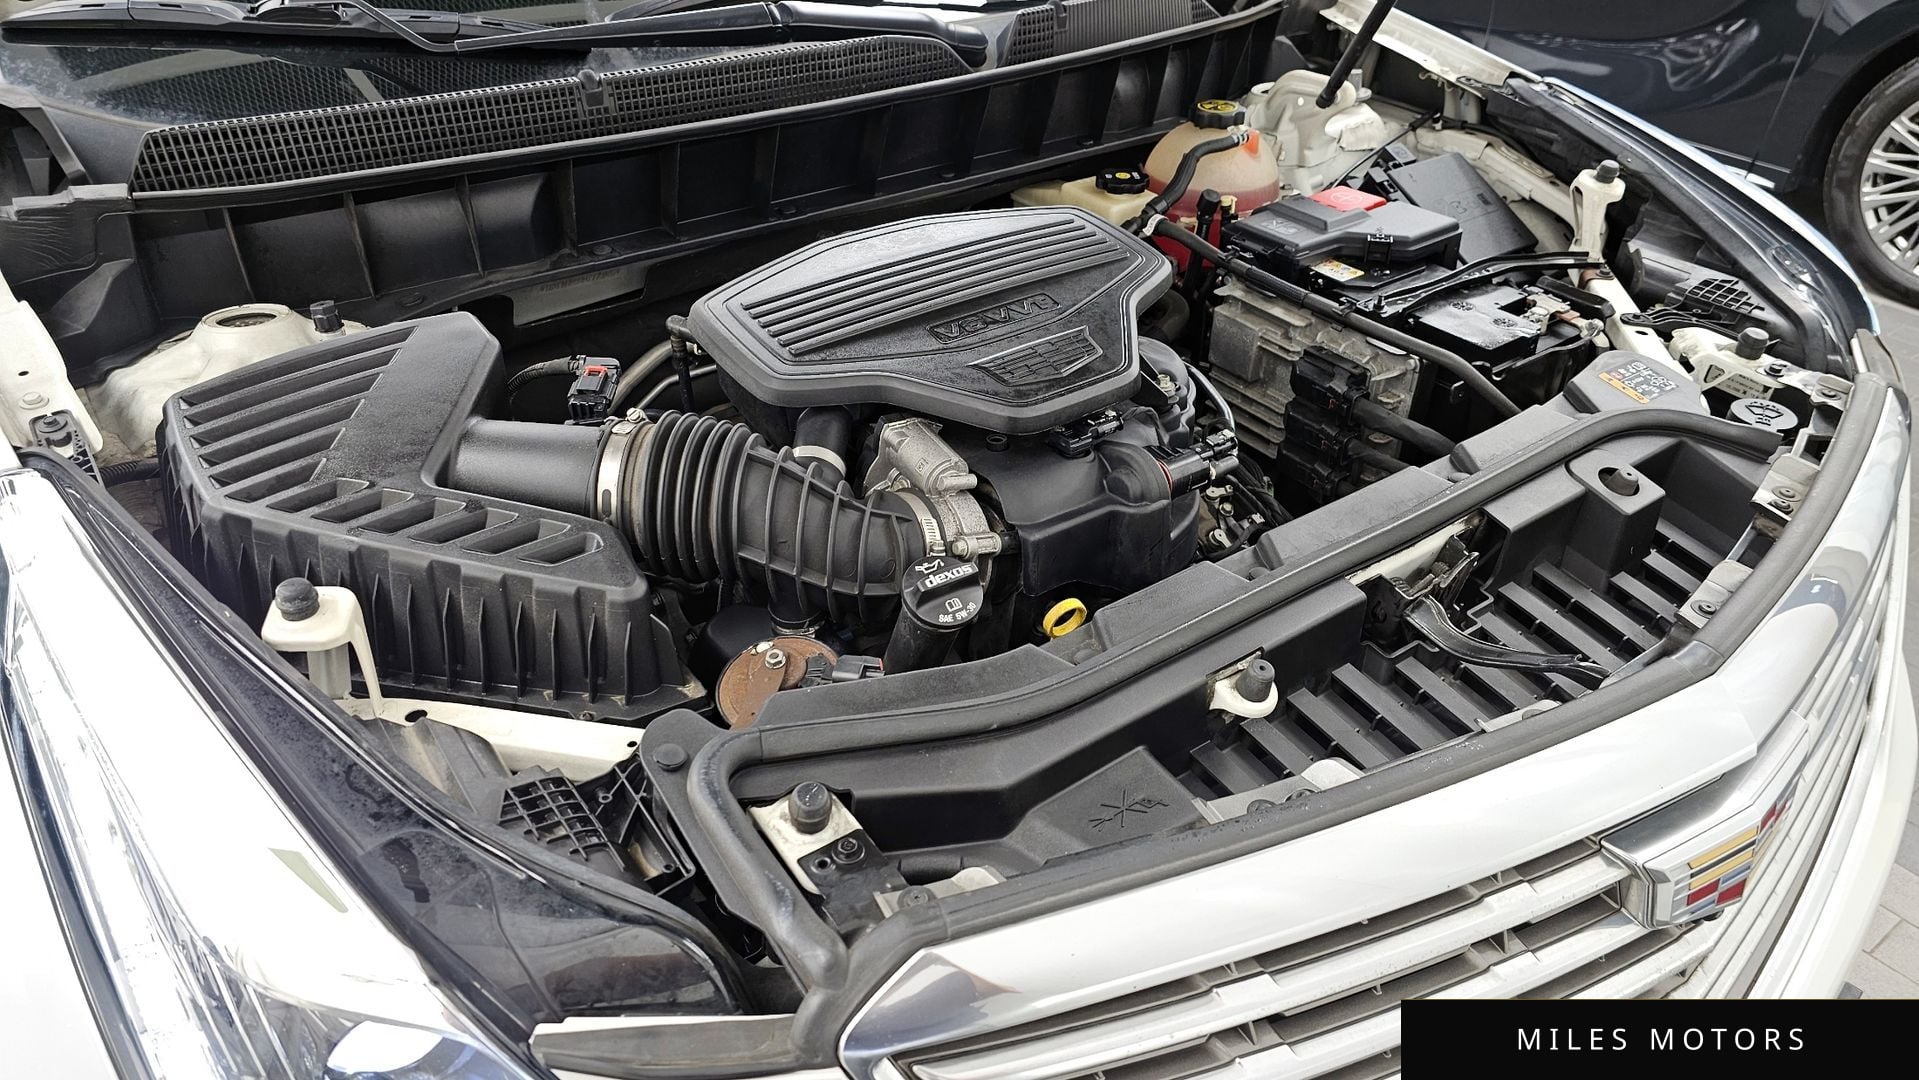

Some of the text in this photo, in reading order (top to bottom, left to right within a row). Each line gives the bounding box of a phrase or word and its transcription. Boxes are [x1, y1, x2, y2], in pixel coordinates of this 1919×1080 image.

[933, 316, 988, 339] V6
[924, 564, 973, 588] dexos
[938, 601, 977, 623] SAE 5W-30
